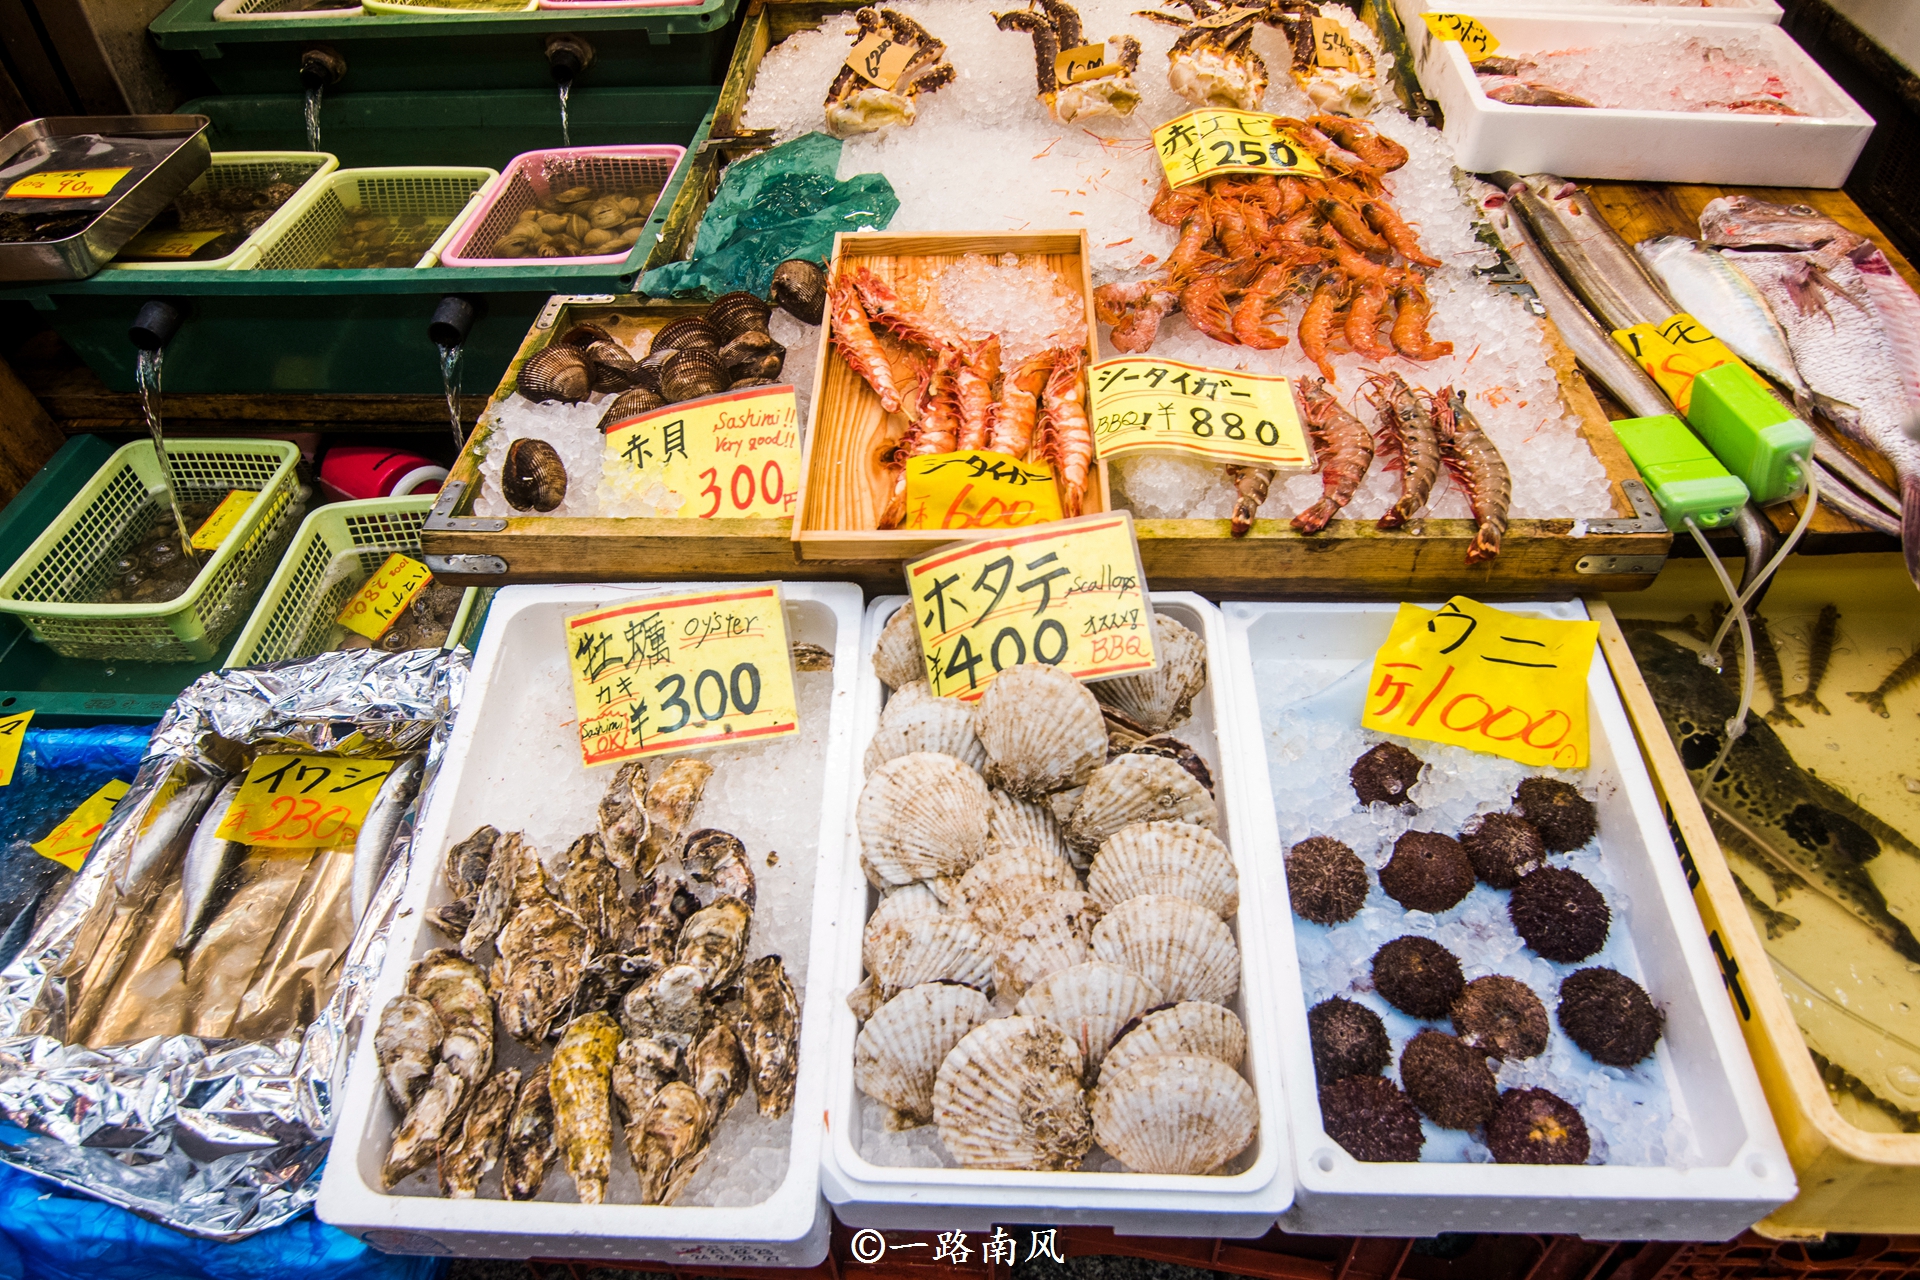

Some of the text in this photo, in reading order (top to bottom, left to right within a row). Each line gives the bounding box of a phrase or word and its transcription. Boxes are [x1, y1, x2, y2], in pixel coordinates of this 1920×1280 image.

[1162, 115, 1272, 157] 赤エビ
[1183, 140, 1299, 174] ¥250
[1097, 367, 1252, 401] シータイガー
[621, 419, 689, 469] 赤貝
[1094, 402, 1281, 447] BBQ! ¥880
[714, 435, 744, 459] Very
[923, 551, 1071, 635] ホタテ
[1091, 634, 1151, 664] BBQ
[1427, 602, 1558, 669] ウニ
[926, 618, 1069, 697] ¥400
[595, 676, 633, 704] カキ
[630, 662, 762, 750] ¥300
[596, 731, 622, 752] OK
[252, 758, 388, 794] イワシ
